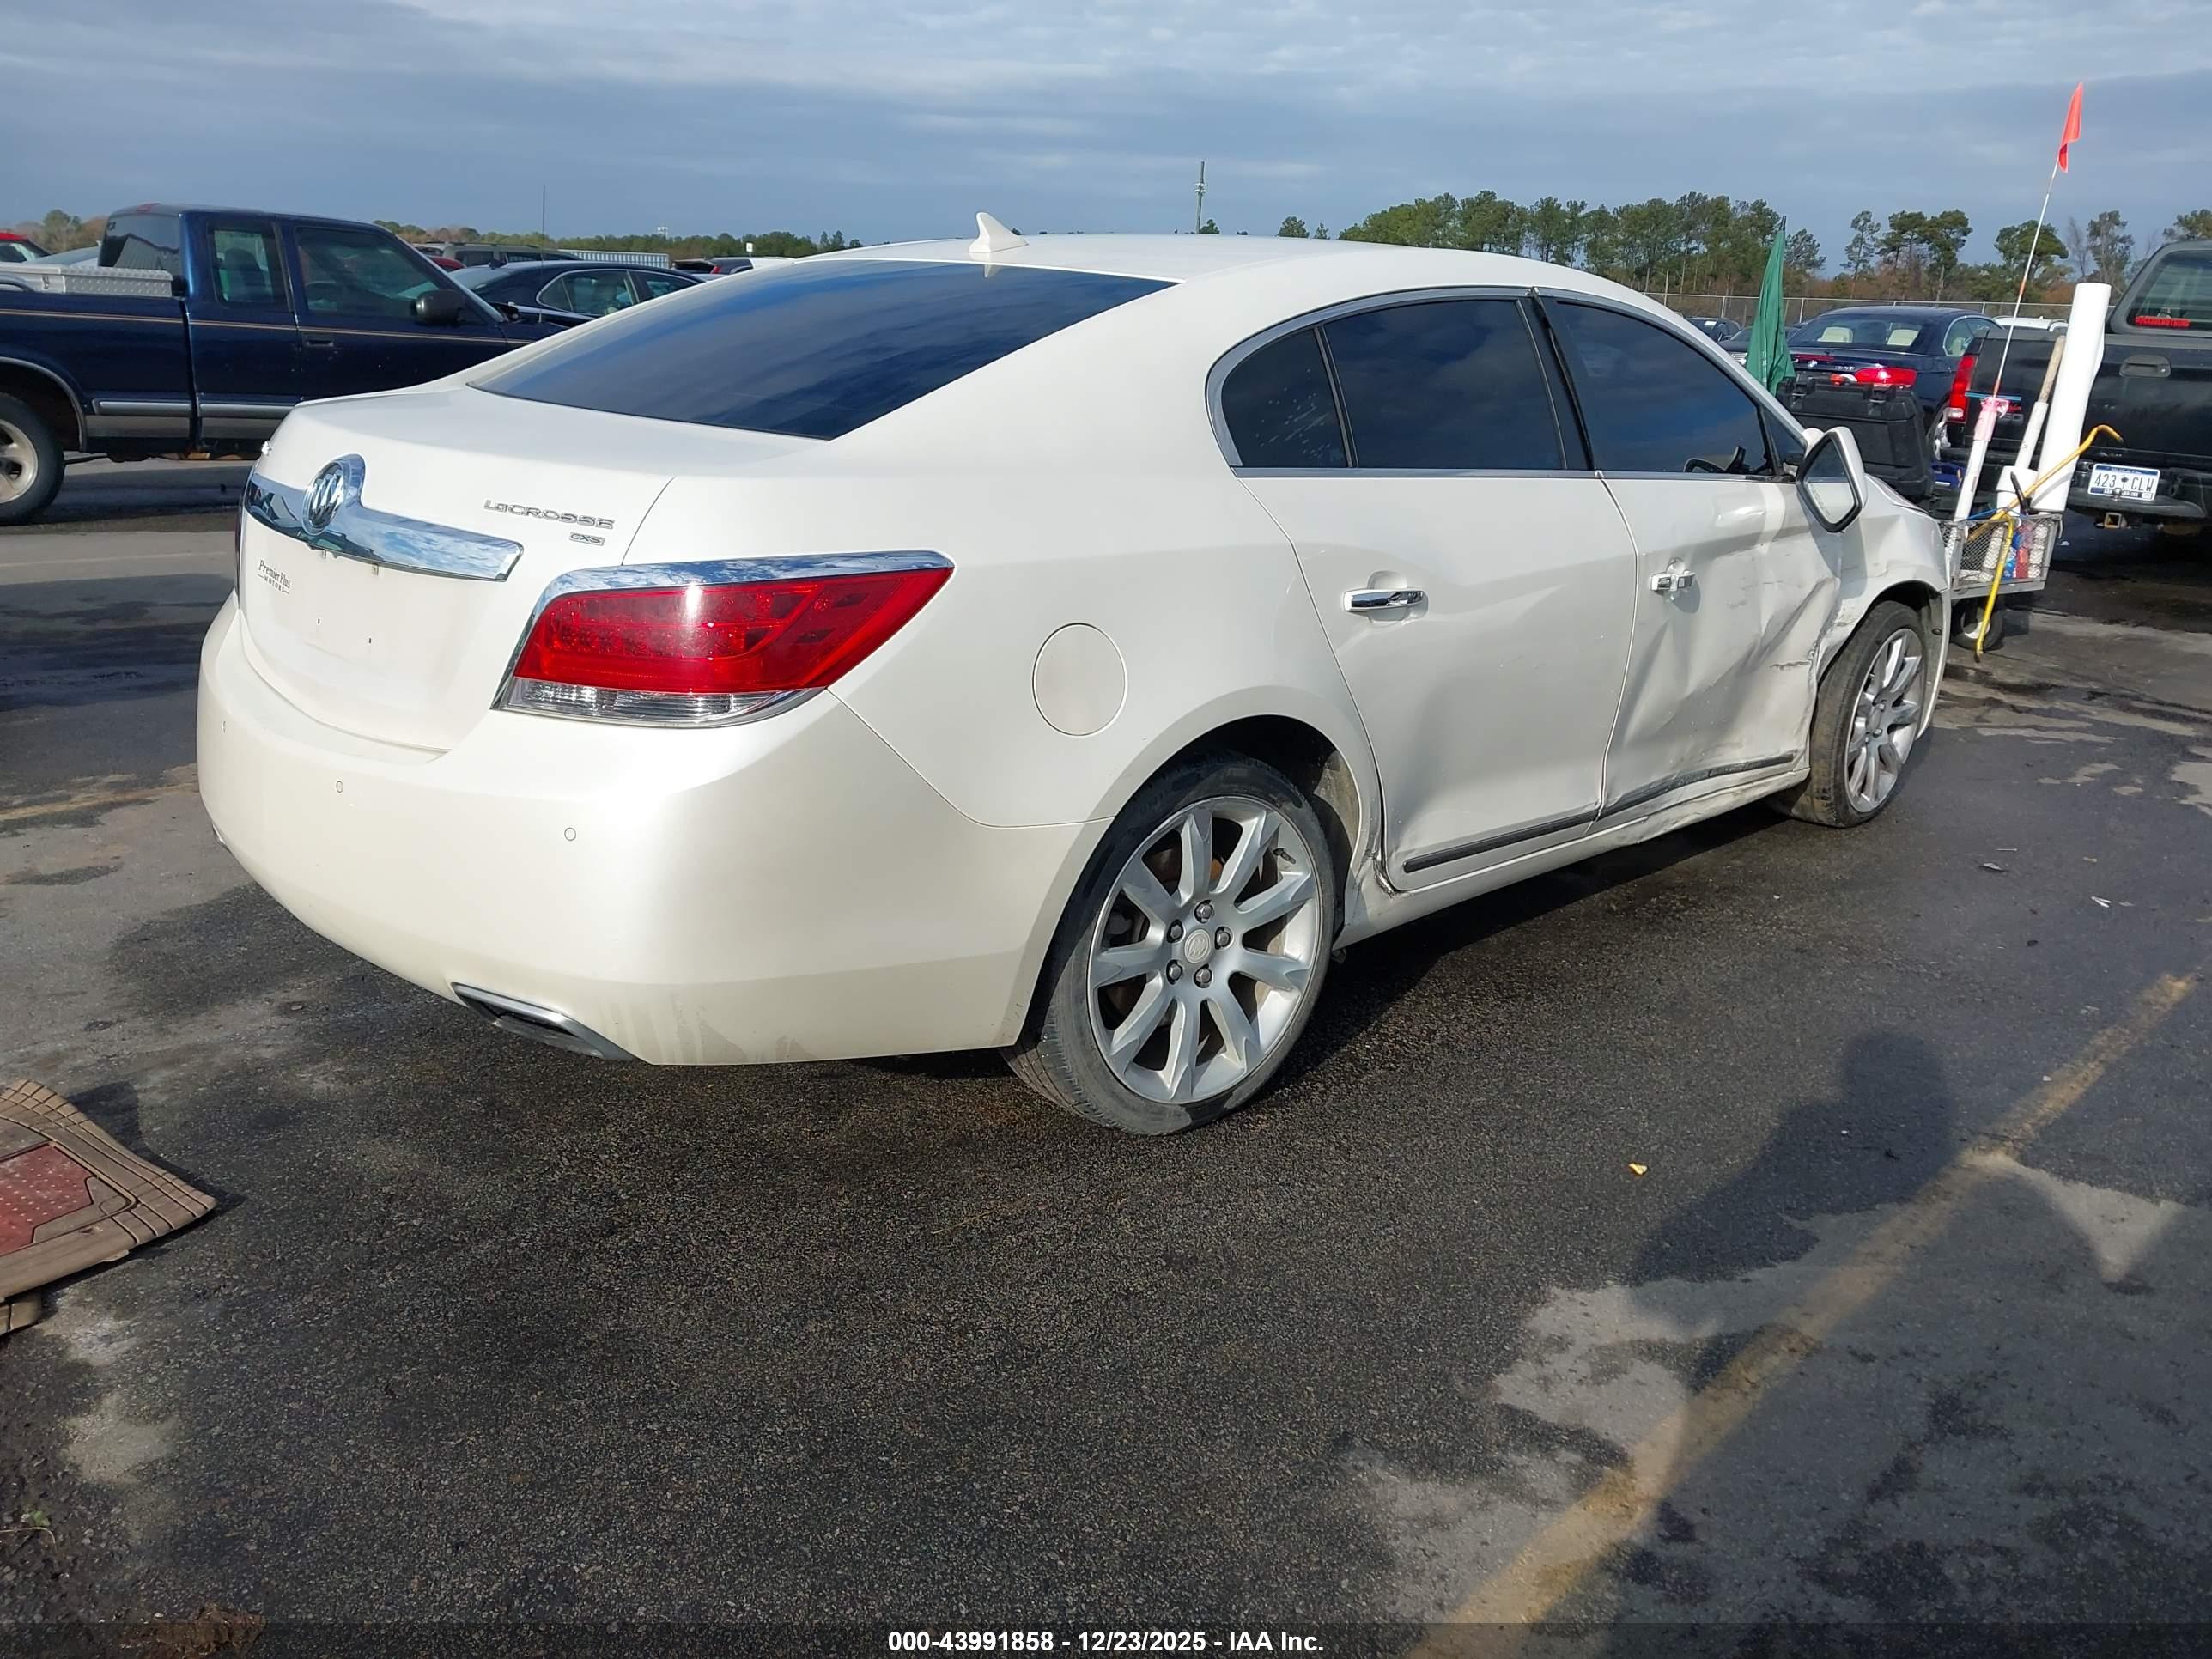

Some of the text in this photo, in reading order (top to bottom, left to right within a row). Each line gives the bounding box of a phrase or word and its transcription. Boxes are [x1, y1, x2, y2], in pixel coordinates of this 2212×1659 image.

[2094, 472, 2117, 488] 423
[569, 532, 603, 544] CXS
[258, 559, 290, 589] Premier Plus
